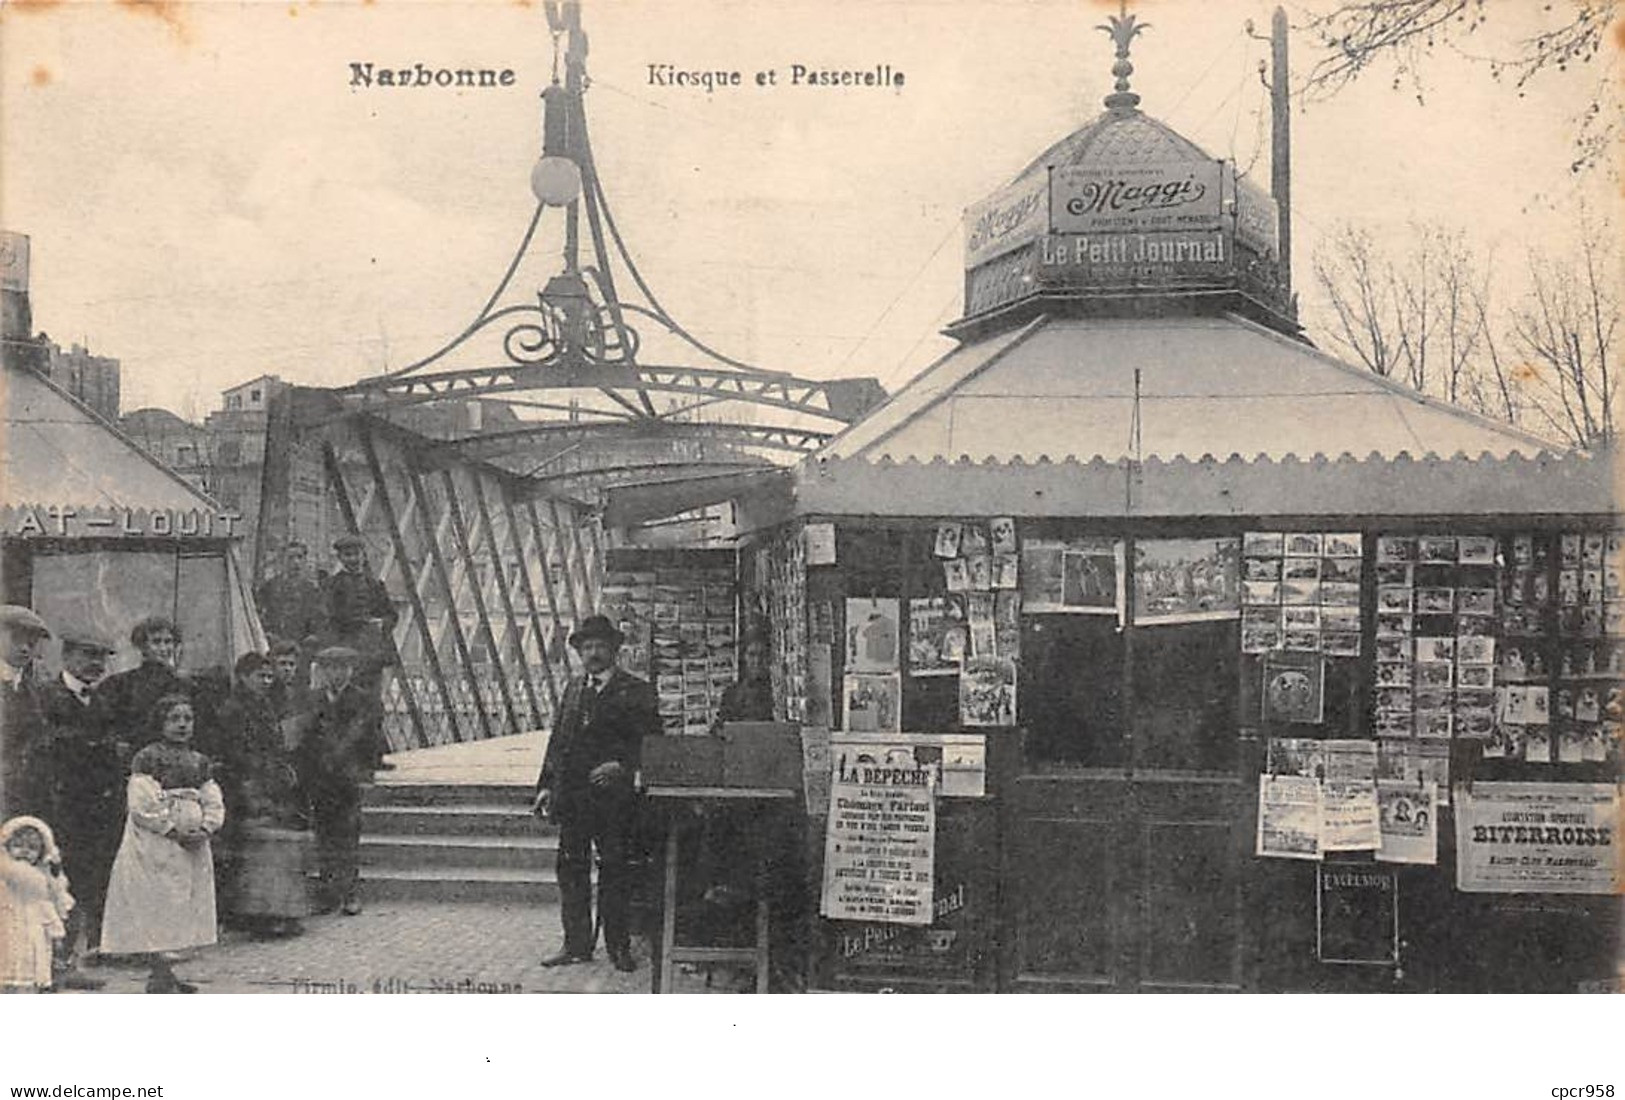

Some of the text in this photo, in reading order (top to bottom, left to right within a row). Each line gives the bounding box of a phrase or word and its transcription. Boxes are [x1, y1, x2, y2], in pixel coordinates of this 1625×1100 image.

[1067, 173, 1206, 216] Maggi
[1041, 234, 1224, 265] Le Petit Journal
[1472, 825, 1612, 848] BITERROISE
